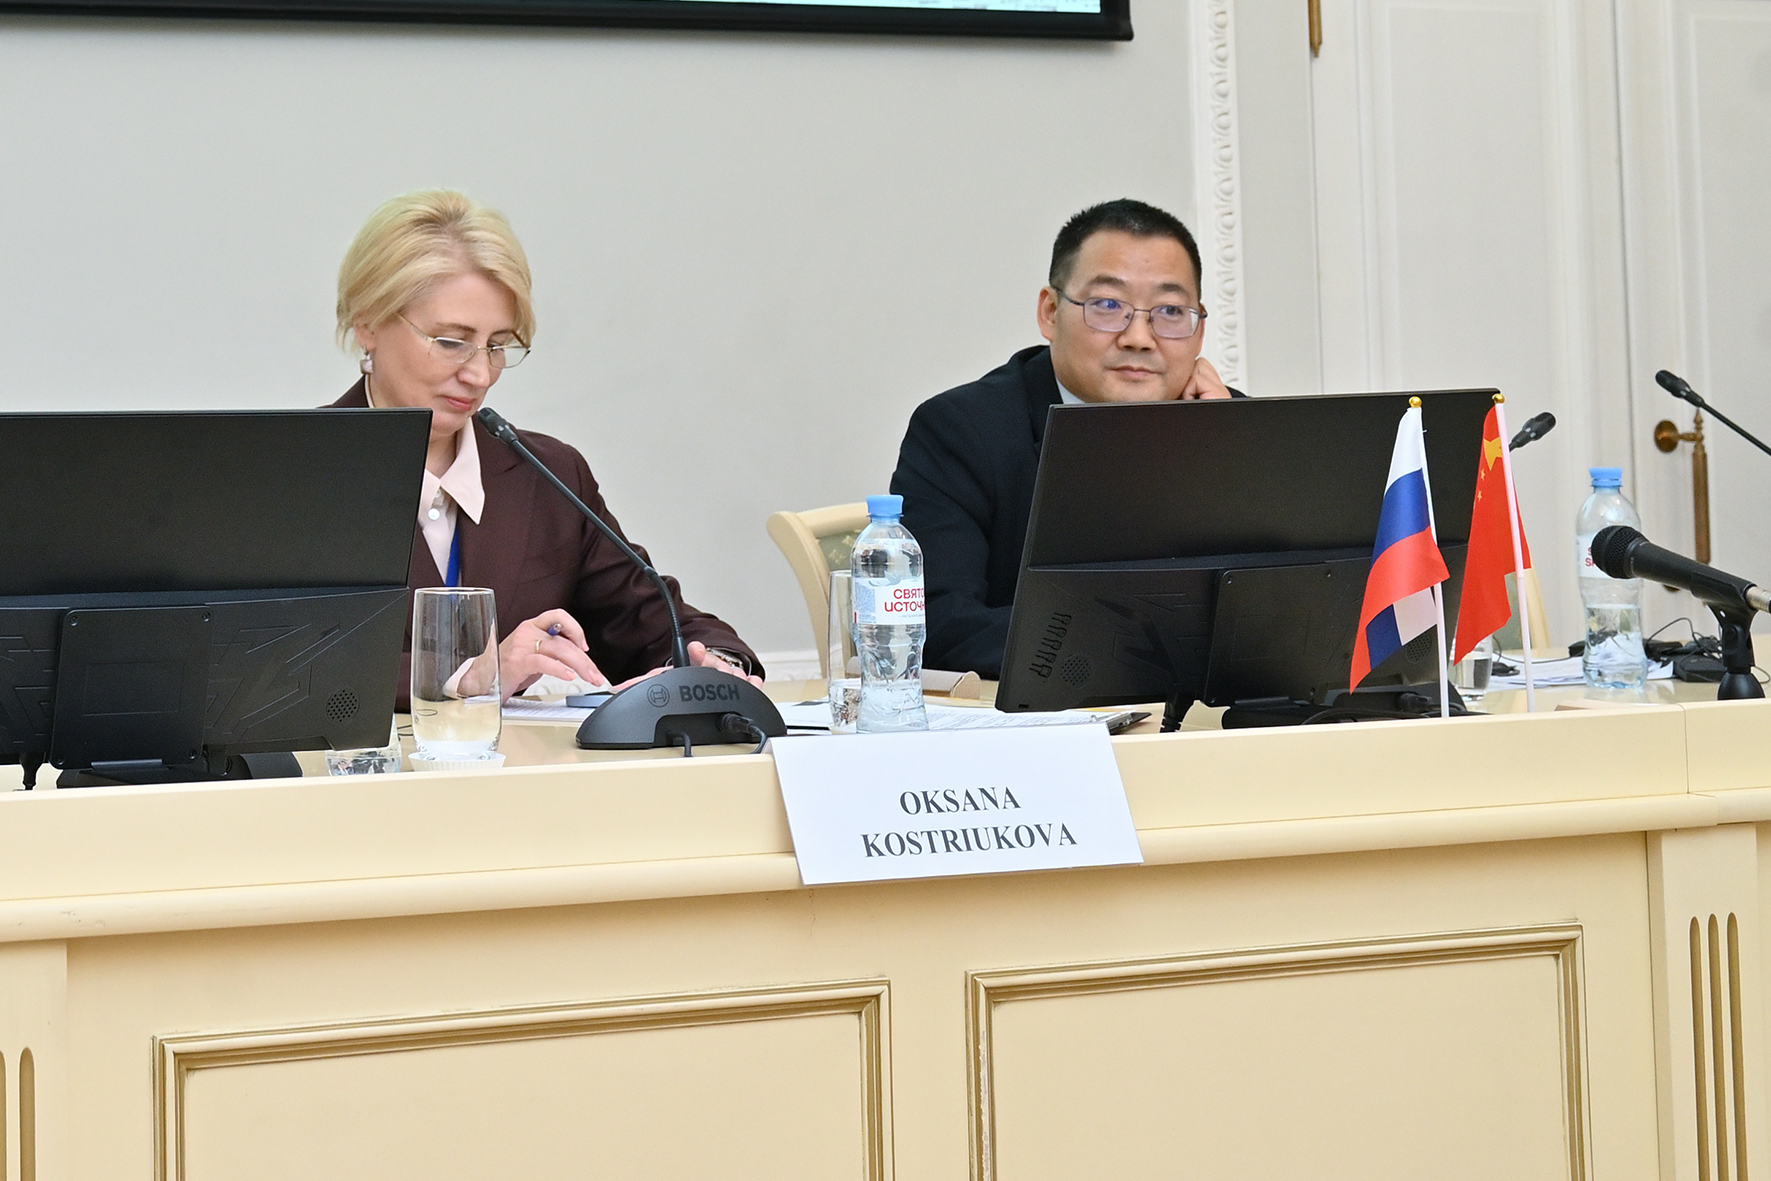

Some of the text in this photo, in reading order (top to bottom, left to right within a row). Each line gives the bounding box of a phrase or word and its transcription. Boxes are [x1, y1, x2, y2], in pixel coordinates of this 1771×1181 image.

[678, 683, 740, 703] BOSCH
[899, 786, 1022, 815] OKSANA
[860, 822, 1078, 858] KOSTRIUKOVA
